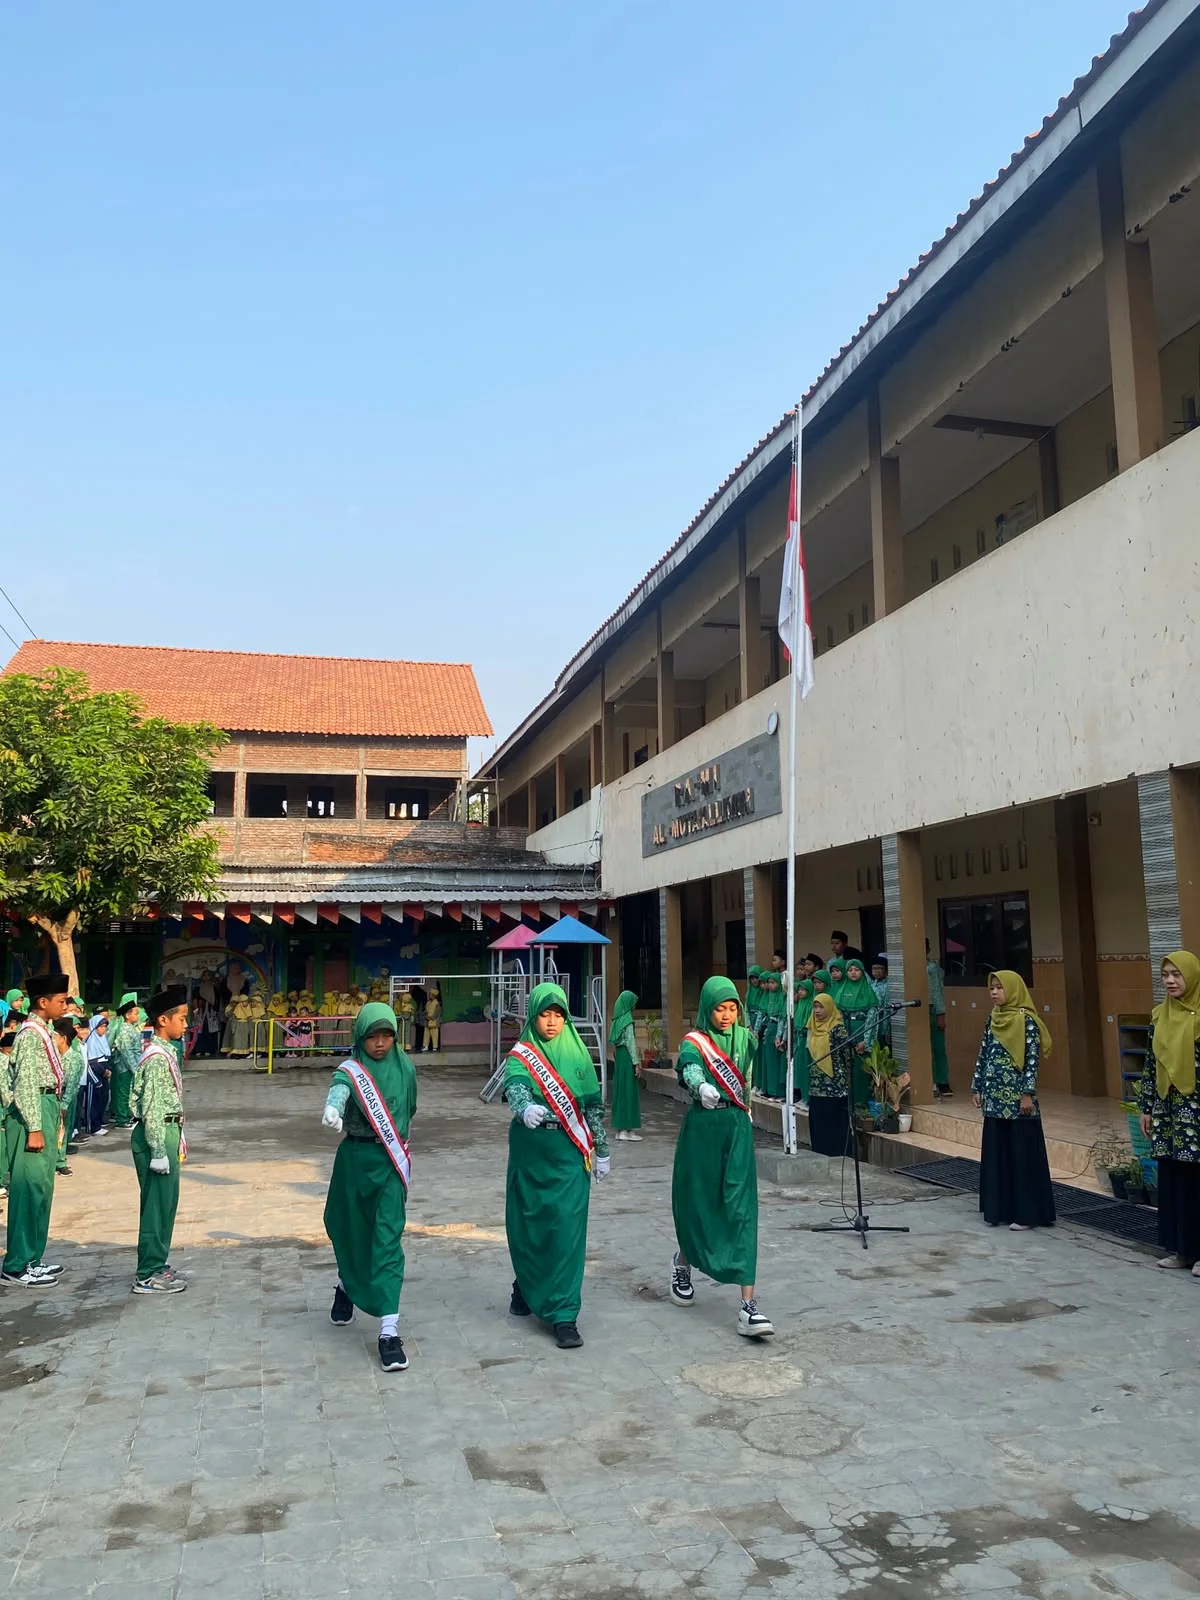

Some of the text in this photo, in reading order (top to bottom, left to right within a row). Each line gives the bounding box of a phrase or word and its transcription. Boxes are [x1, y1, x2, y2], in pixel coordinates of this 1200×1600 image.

[652, 823, 667, 845] AL
[521, 1048, 575, 1120] PETUGAS UPACARA
[712, 1058, 739, 1091] PETUGAS
[356, 1073, 395, 1146] PETUGAS UPACARA
